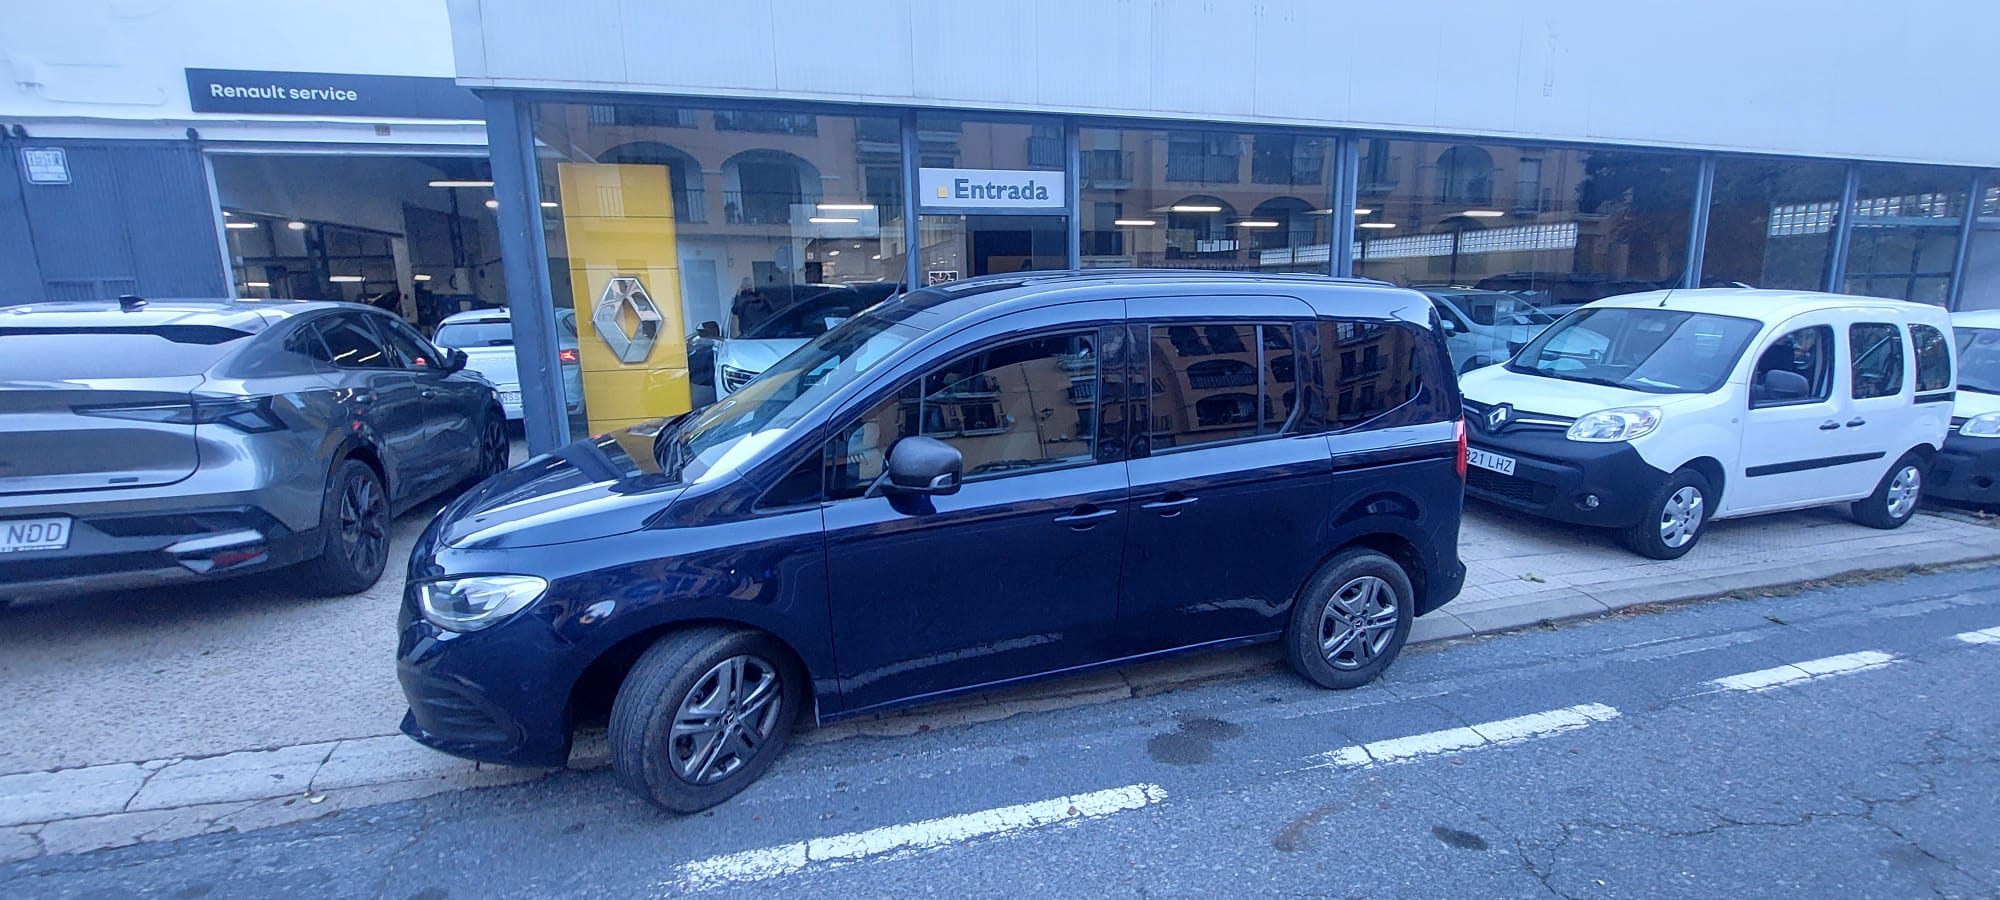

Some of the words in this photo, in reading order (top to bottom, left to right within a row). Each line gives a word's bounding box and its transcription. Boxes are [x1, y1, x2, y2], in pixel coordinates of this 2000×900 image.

[210, 84, 286, 98] Renault
[289, 87, 357, 100] service
[954, 178, 1049, 200] Entrada
[1488, 456, 1513, 472] LHZ
[7, 523, 62, 544] NDD
